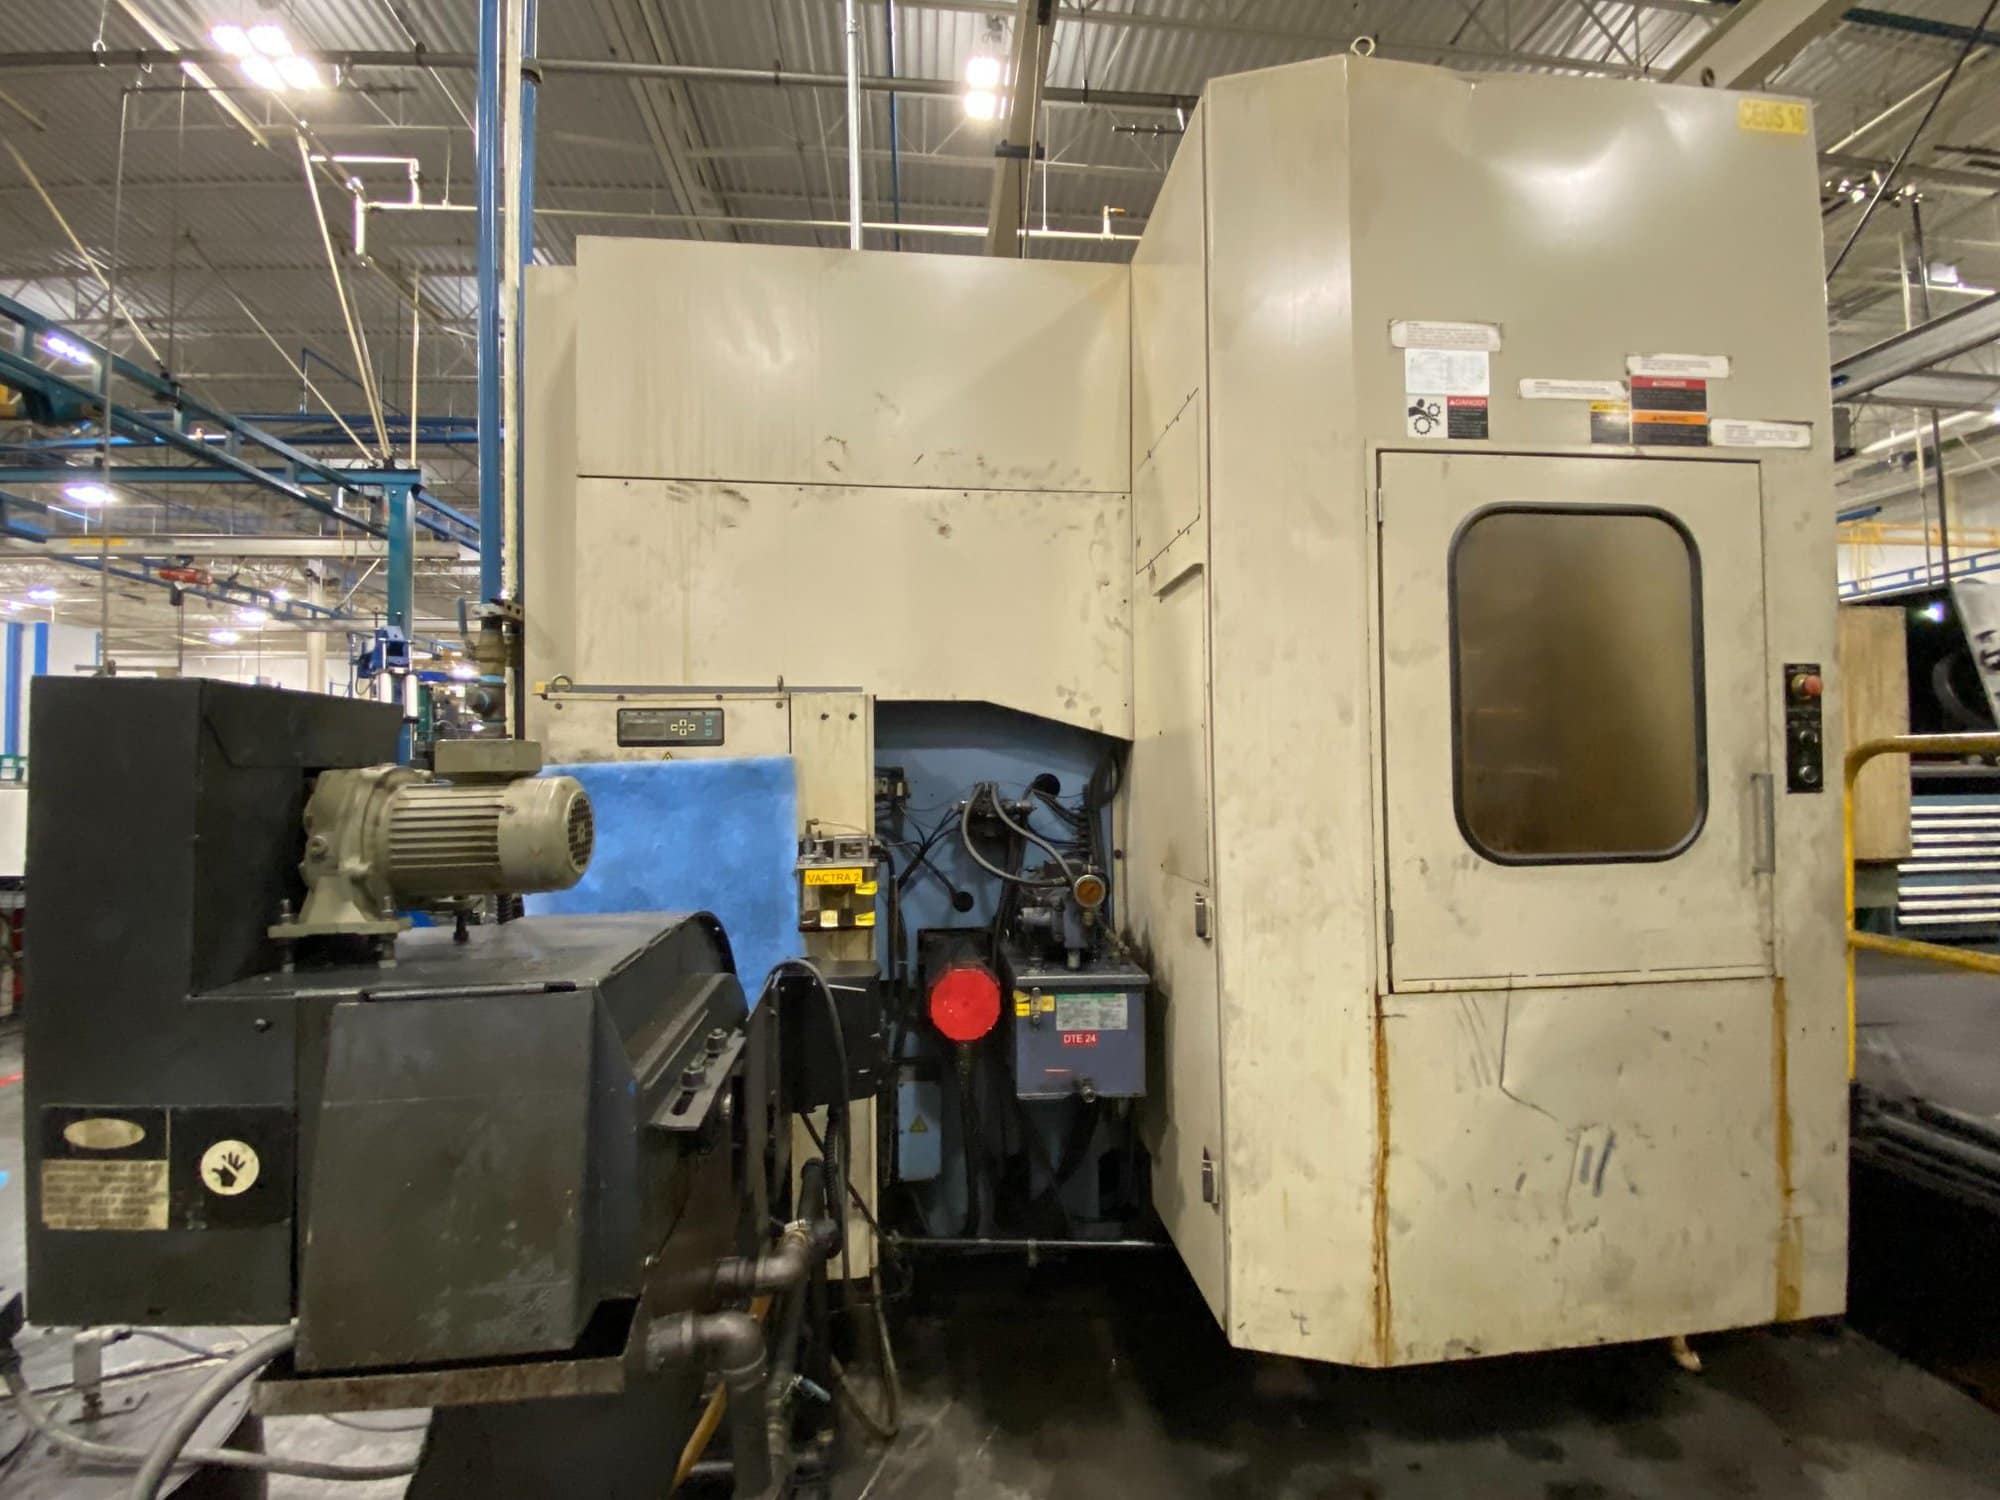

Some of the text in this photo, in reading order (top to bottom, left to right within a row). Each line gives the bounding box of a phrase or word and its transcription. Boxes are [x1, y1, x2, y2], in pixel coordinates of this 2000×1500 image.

[807, 872, 860, 883] VACTRA 2
[1063, 1033, 1097, 1044] DTE 24
